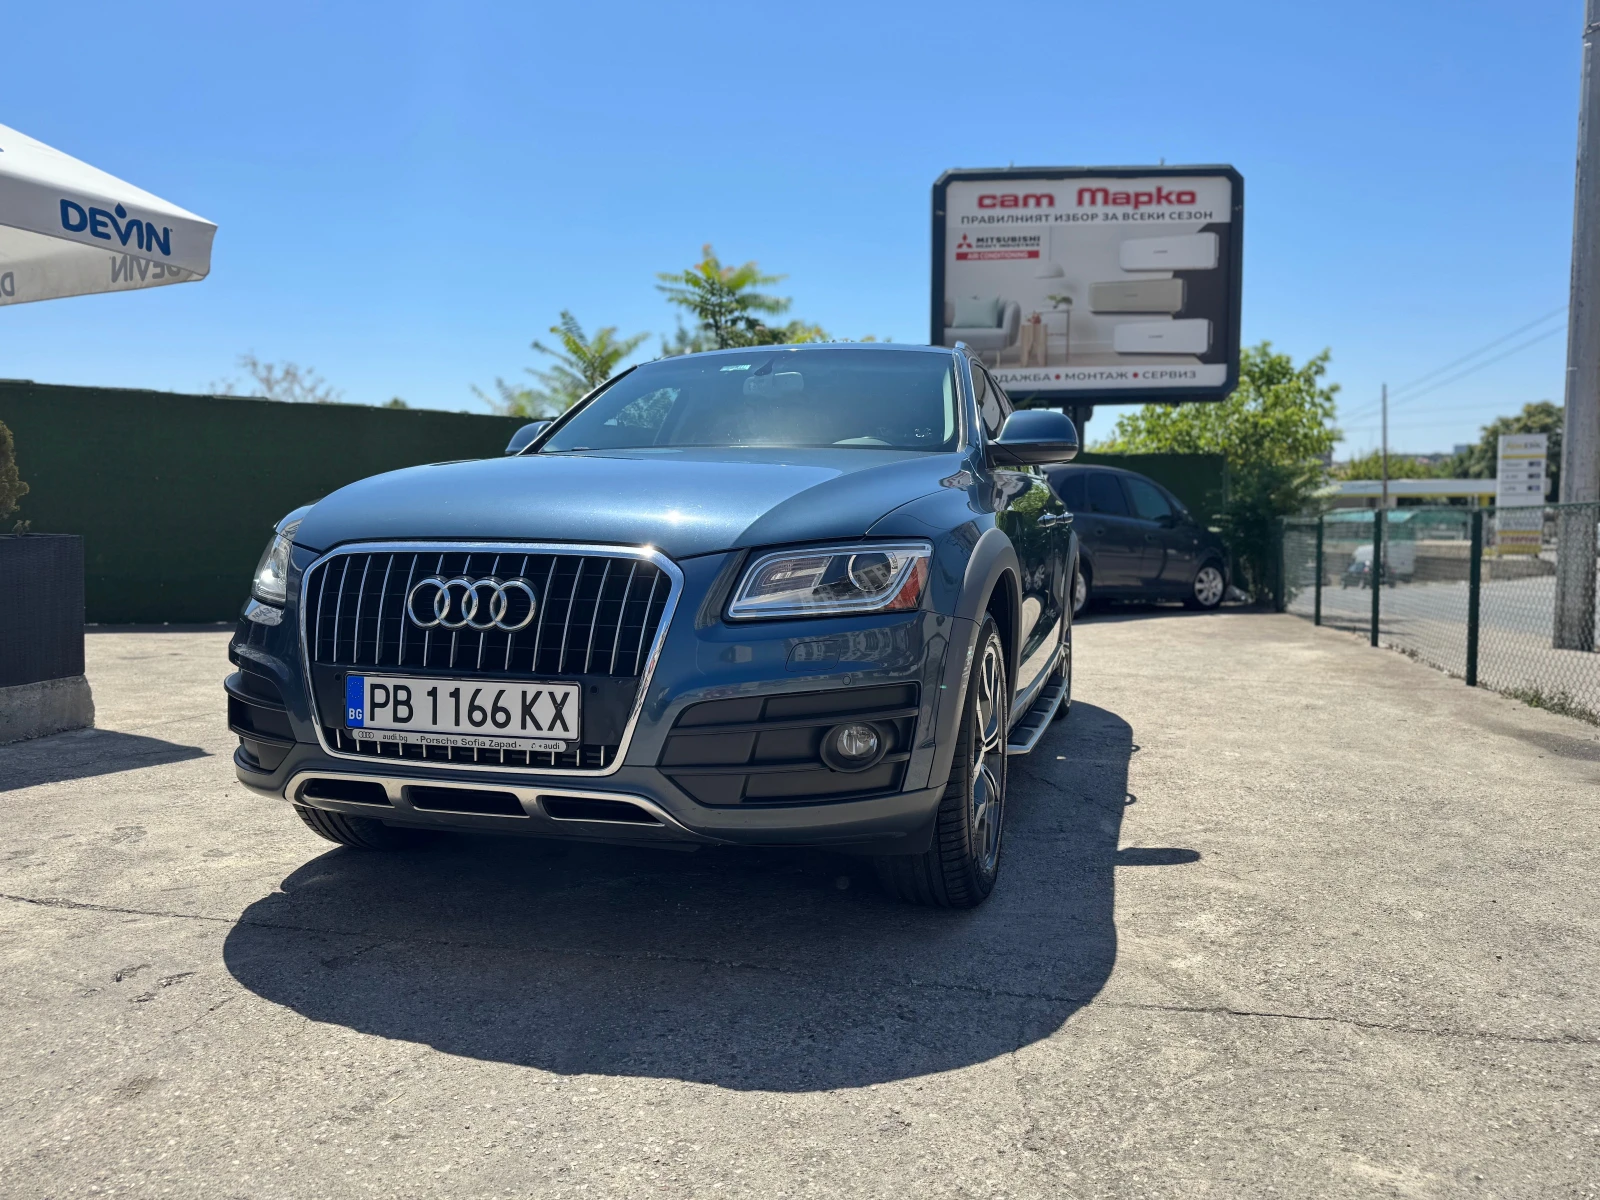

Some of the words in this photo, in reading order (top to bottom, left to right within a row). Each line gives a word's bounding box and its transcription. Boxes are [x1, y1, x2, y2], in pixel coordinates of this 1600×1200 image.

[961, 214, 1051, 225] ПРАВИЛНИЯТ
[1054, 212, 1099, 222] ИЗБОР
[1102, 212, 1119, 222] ЗА
[1122, 211, 1166, 221] ВСЕКИ
[1169, 210, 1213, 220] СЕЗОН
[60, 198, 172, 256] DEVIN
[975, 236, 1041, 244] MITSUBISHI
[1064, 371, 1129, 381] МОНТАЖ
[1142, 370, 1197, 380] СЕРВИЗ
[348, 708, 363, 720] BG
[369, 683, 414, 724] PB
[427, 686, 512, 729] 1166
[520, 690, 571, 733] KX
[382, 733, 408, 743] audi.bg
[420, 736, 458, 745] Porsche
[461, 738, 486, 747] Sofia
[488, 739, 517, 749] Zapad
